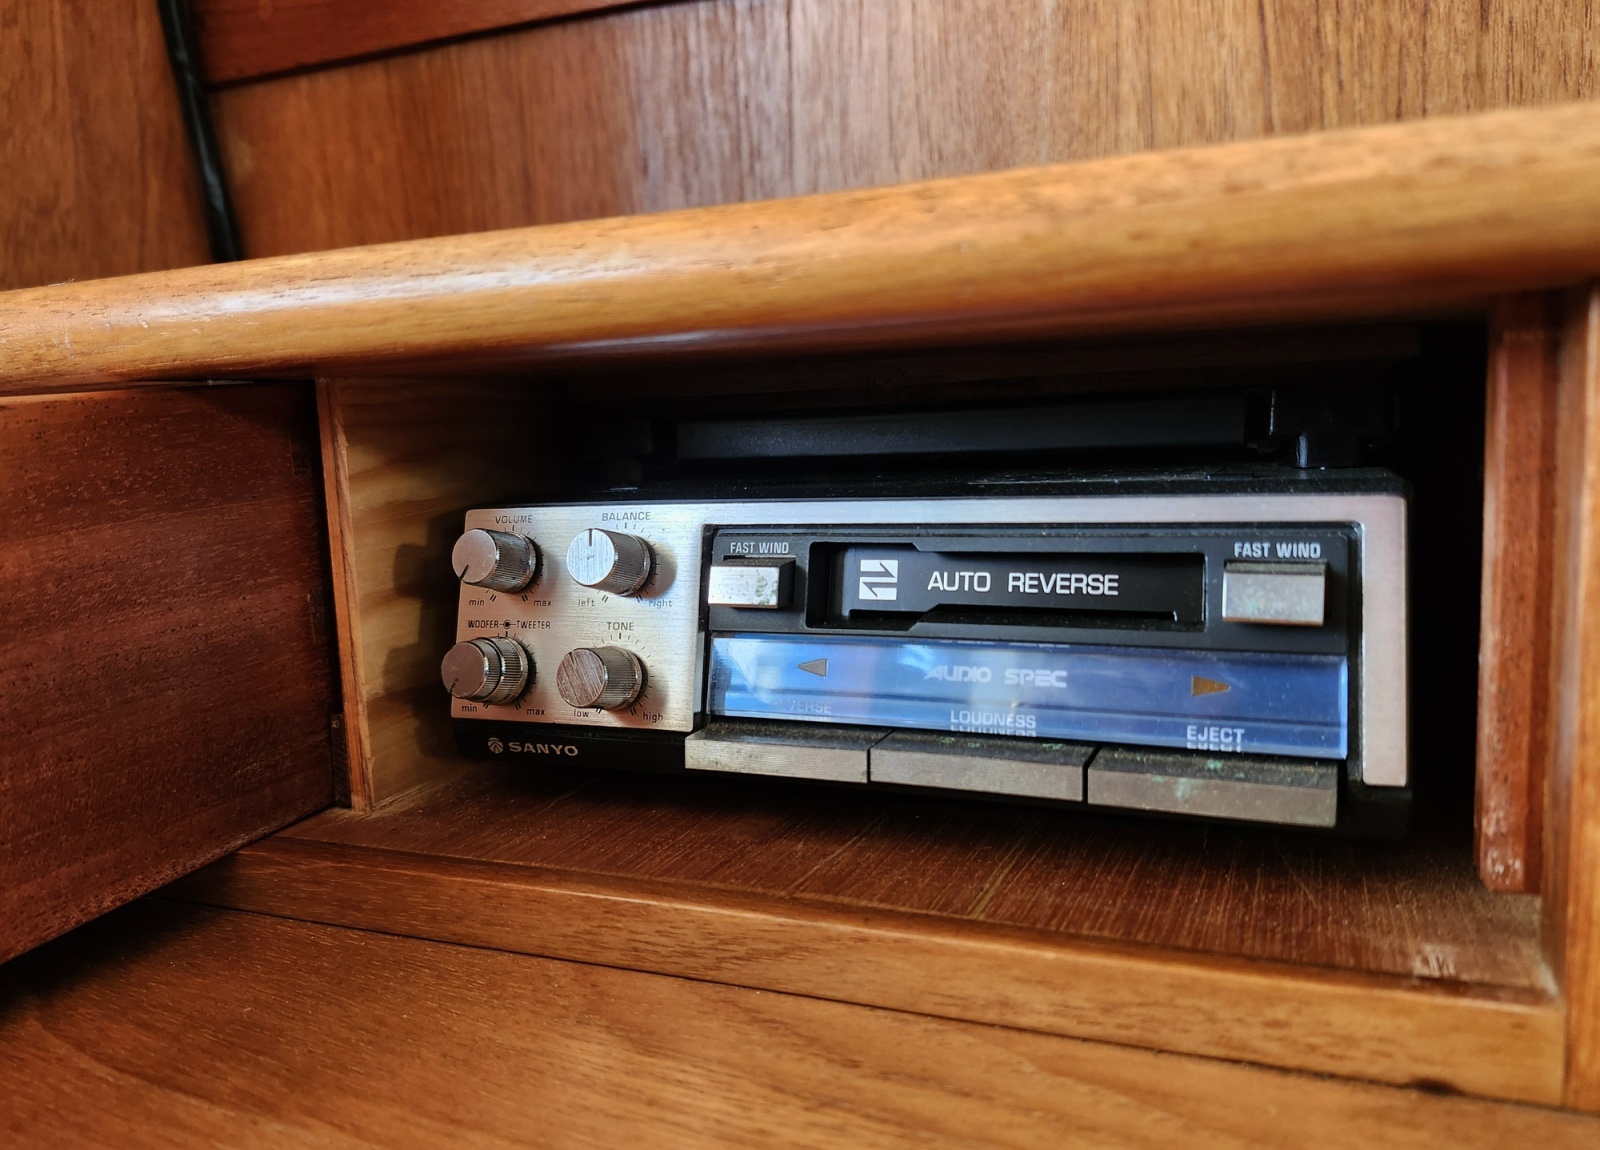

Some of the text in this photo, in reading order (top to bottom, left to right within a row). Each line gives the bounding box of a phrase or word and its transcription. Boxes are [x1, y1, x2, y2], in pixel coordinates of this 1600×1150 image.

[495, 515, 533, 524] VOLUME
[602, 512, 651, 522] BALANCE
[730, 542, 789, 554] FAST WIND
[1234, 542, 1321, 559] FAST WIND
[927, 571, 1119, 596] AUTO REVERSE
[469, 598, 485, 606] min
[533, 599, 551, 607] max
[578, 598, 595, 607] left
[648, 599, 673, 609] right
[468, 620, 551, 630] WOOFER TWEETER
[606, 621, 634, 631] TONE
[923, 664, 1068, 688] AUDIO SPEC
[461, 704, 478, 712] min
[527, 706, 545, 716] max
[573, 708, 590, 718] low
[643, 712, 663, 724] high
[951, 710, 1036, 729] LOUDNESS
[1187, 725, 1245, 744] EJECT
[508, 741, 579, 757] SANYO
